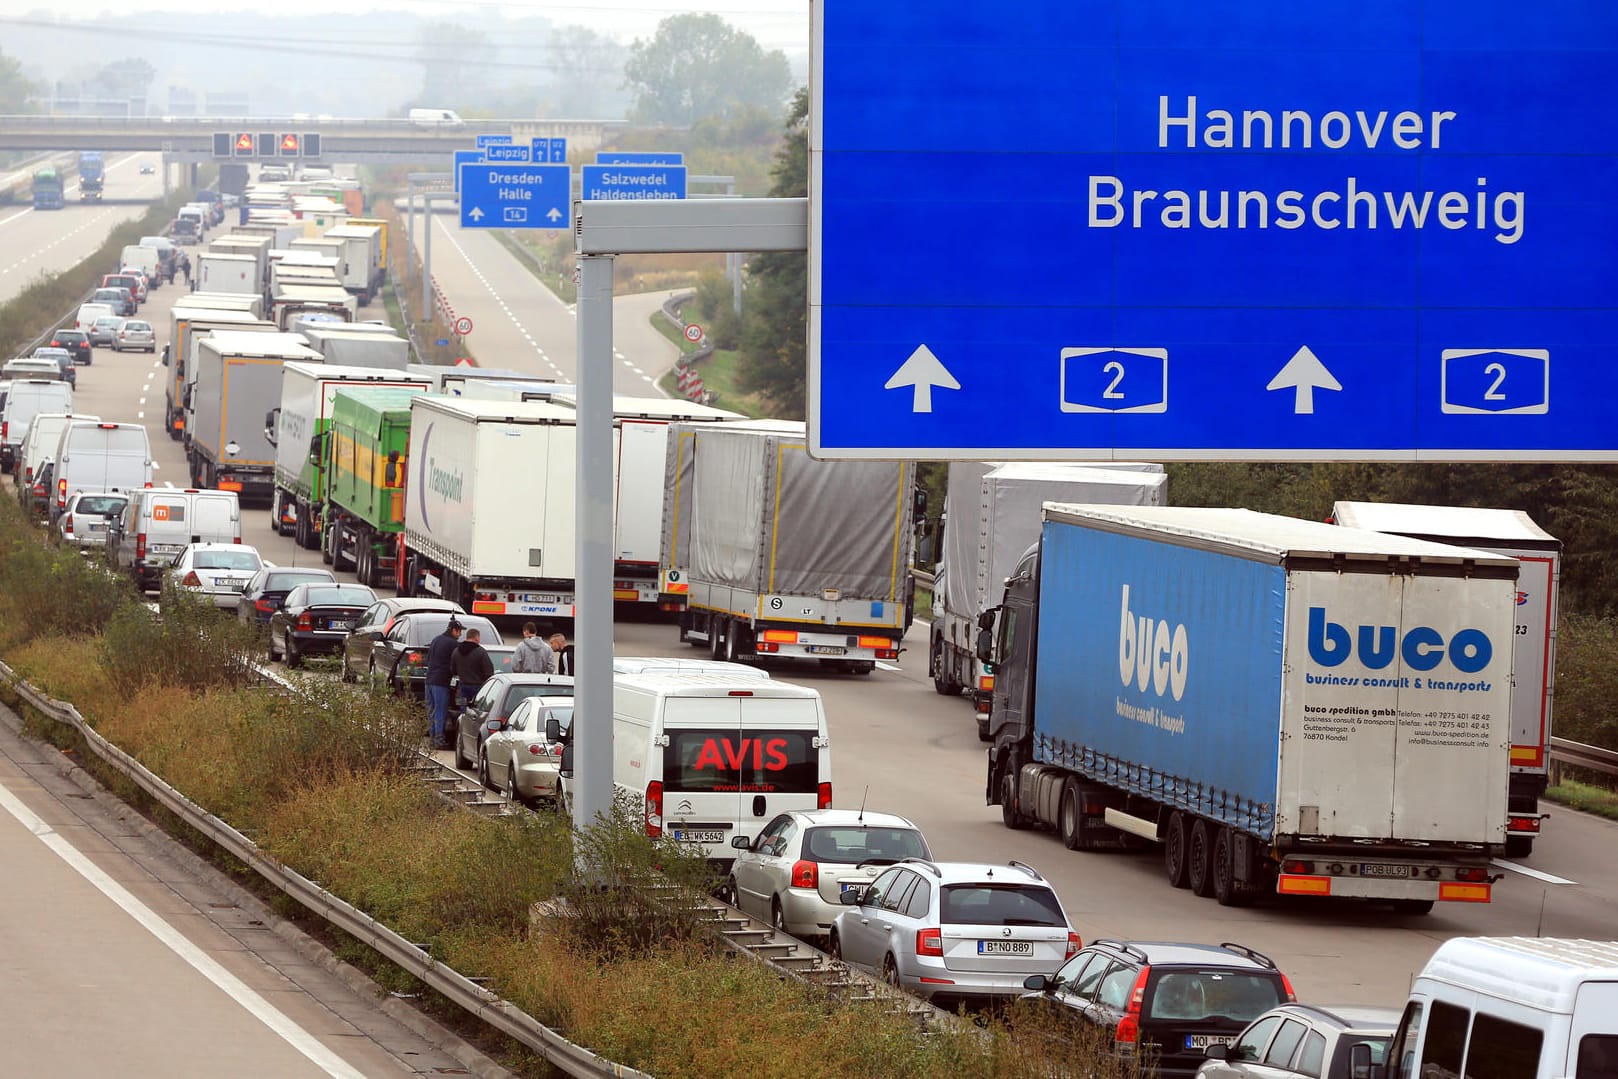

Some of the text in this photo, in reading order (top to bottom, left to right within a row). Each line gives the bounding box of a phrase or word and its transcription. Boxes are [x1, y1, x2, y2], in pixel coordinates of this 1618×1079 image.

[1158, 95, 1456, 149] Hannover
[489, 147, 528, 160] Leipzig
[489, 172, 542, 184] Dresden
[602, 173, 667, 186] Salzwedel
[499, 188, 532, 200] Halle
[591, 189, 678, 200] Haldensleben
[510, 210, 521, 219] 14
[1088, 175, 1526, 244] Braunschweig
[459, 322, 470, 331] 60
[688, 329, 698, 338] 60
[1102, 362, 1125, 399] 2
[1484, 363, 1506, 400] 2
[428, 457, 463, 504] Transpoint
[1120, 584, 1188, 702] buco
[1308, 607, 1493, 674] buco
[1306, 673, 1492, 692] business consult & transports
[1304, 704, 1396, 718] buco spedition gmbh
[694, 738, 788, 772] AVIS
[713, 783, 775, 792] www.avis.de
[704, 832, 723, 840] 5642
[1366, 866, 1384, 874] POB
[1000, 944, 1011, 952] NO
[1012, 944, 1030, 952] 889
